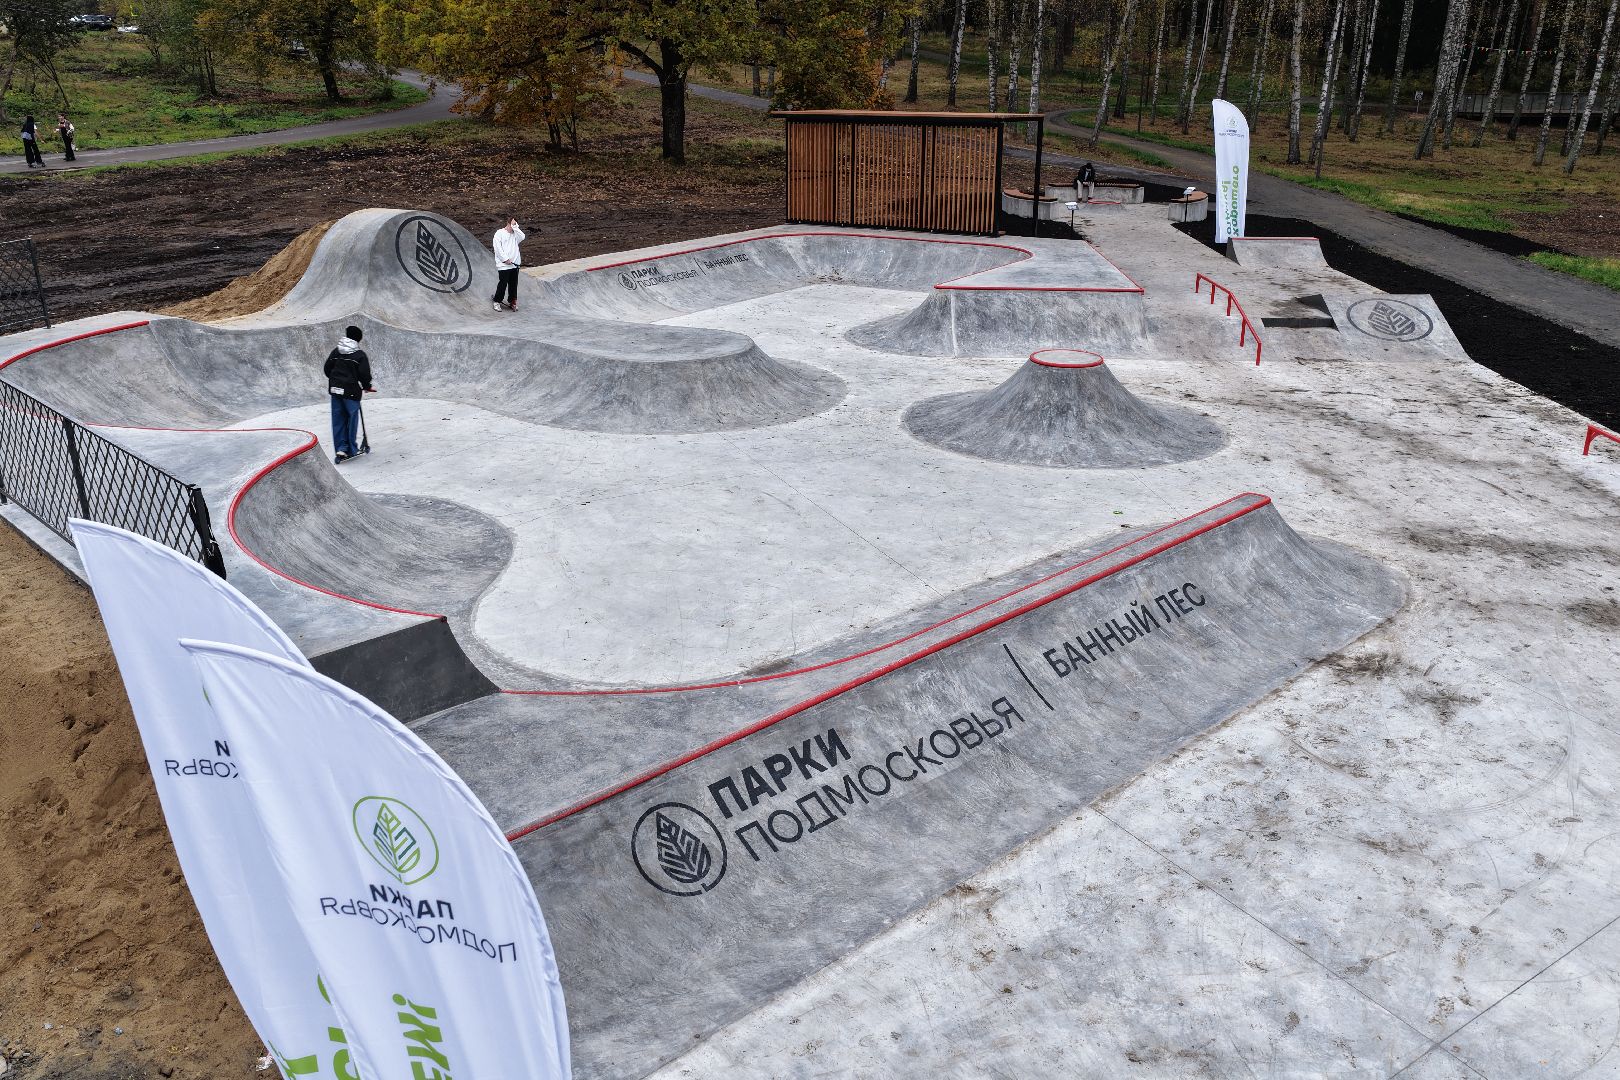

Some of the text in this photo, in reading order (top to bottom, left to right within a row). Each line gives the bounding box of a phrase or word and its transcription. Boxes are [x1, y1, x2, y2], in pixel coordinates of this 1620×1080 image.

[630, 266, 660, 279] ПАРКИ
[637, 269, 699, 287] ПОДМОСКОВЬЯ
[704, 253, 749, 269] БАННЫЙ ЛЕС
[1043, 582, 1207, 678] БАННЫЙ ЛЕС
[707, 728, 851, 819] ПАРКИ
[735, 696, 1025, 861] ПОДМОСКОВЬЯ
